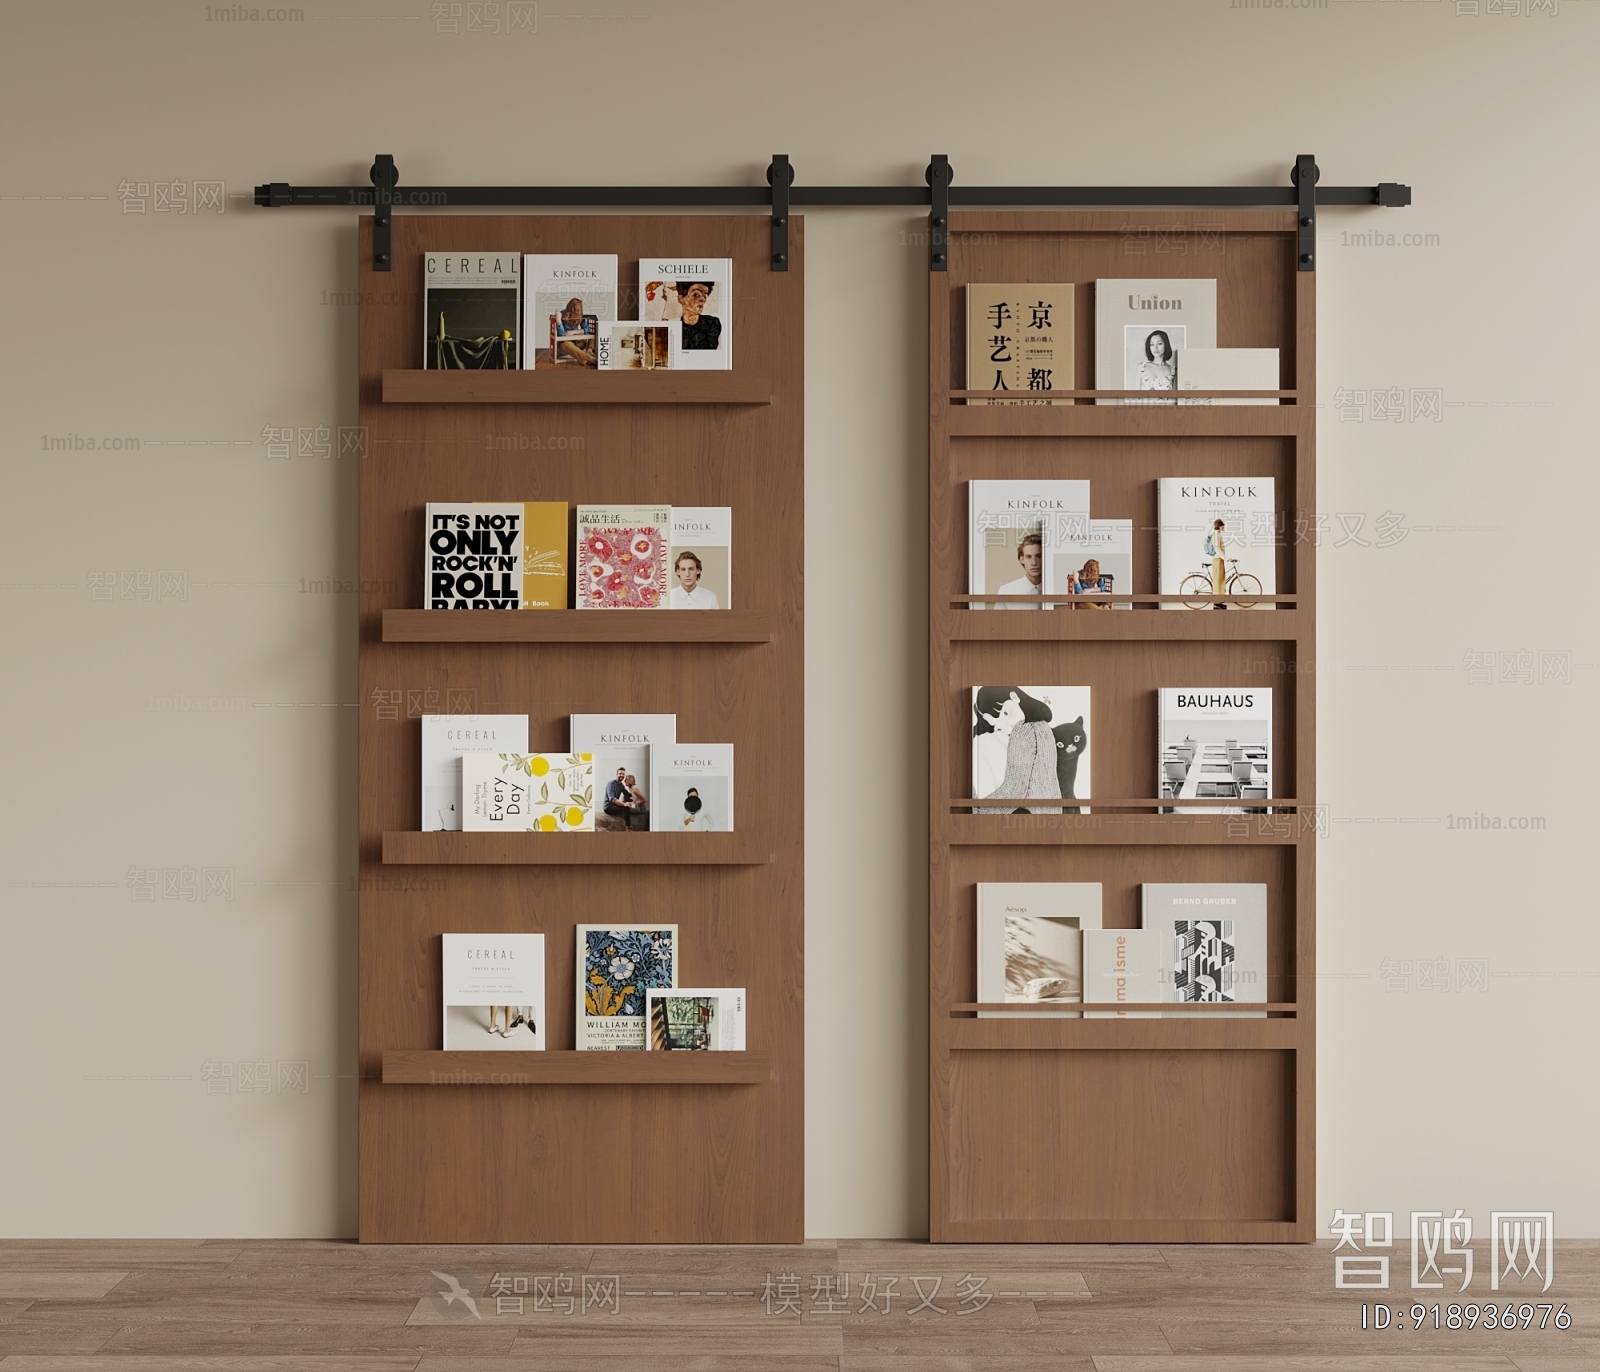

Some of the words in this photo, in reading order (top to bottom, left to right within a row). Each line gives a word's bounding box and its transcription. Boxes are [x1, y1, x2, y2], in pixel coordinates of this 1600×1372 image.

[427, 258, 518, 274] CEREAL
[553, 270, 597, 278] KINFOLK
[658, 264, 709, 274] SCHIELE
[1128, 293, 1183, 311] Union
[599, 337, 610, 366] HOME
[986, 301, 1013, 390] 手艺人
[1181, 486, 1258, 498] KINFOLK
[1007, 499, 1064, 509] KINFOLK
[432, 514, 470, 530] IT'S
[475, 514, 520, 530] NOT
[671, 523, 712, 531] INFOLK
[429, 529, 519, 555] ONLY
[579, 540, 587, 568] MORE
[659, 539, 667, 563] LOVE
[432, 555, 518, 571] ROCK'N'
[431, 572, 518, 599] ROLL
[579, 572, 587, 597] LOVE
[659, 568, 667, 597] MORE
[1177, 694, 1254, 708] BAUHAUS
[447, 730, 497, 740] CEREAL
[600, 734, 650, 743] KINFOLK
[474, 784, 482, 807] Darling
[481, 781, 489, 800] Thyme
[489, 777, 508, 821] Every
[506, 783, 525, 815] Day
[474, 807, 481, 815] My
[467, 949, 514, 960] CEREAL
[1113, 935, 1126, 972] isme
[586, 1021, 629, 1029] WILLIAM
